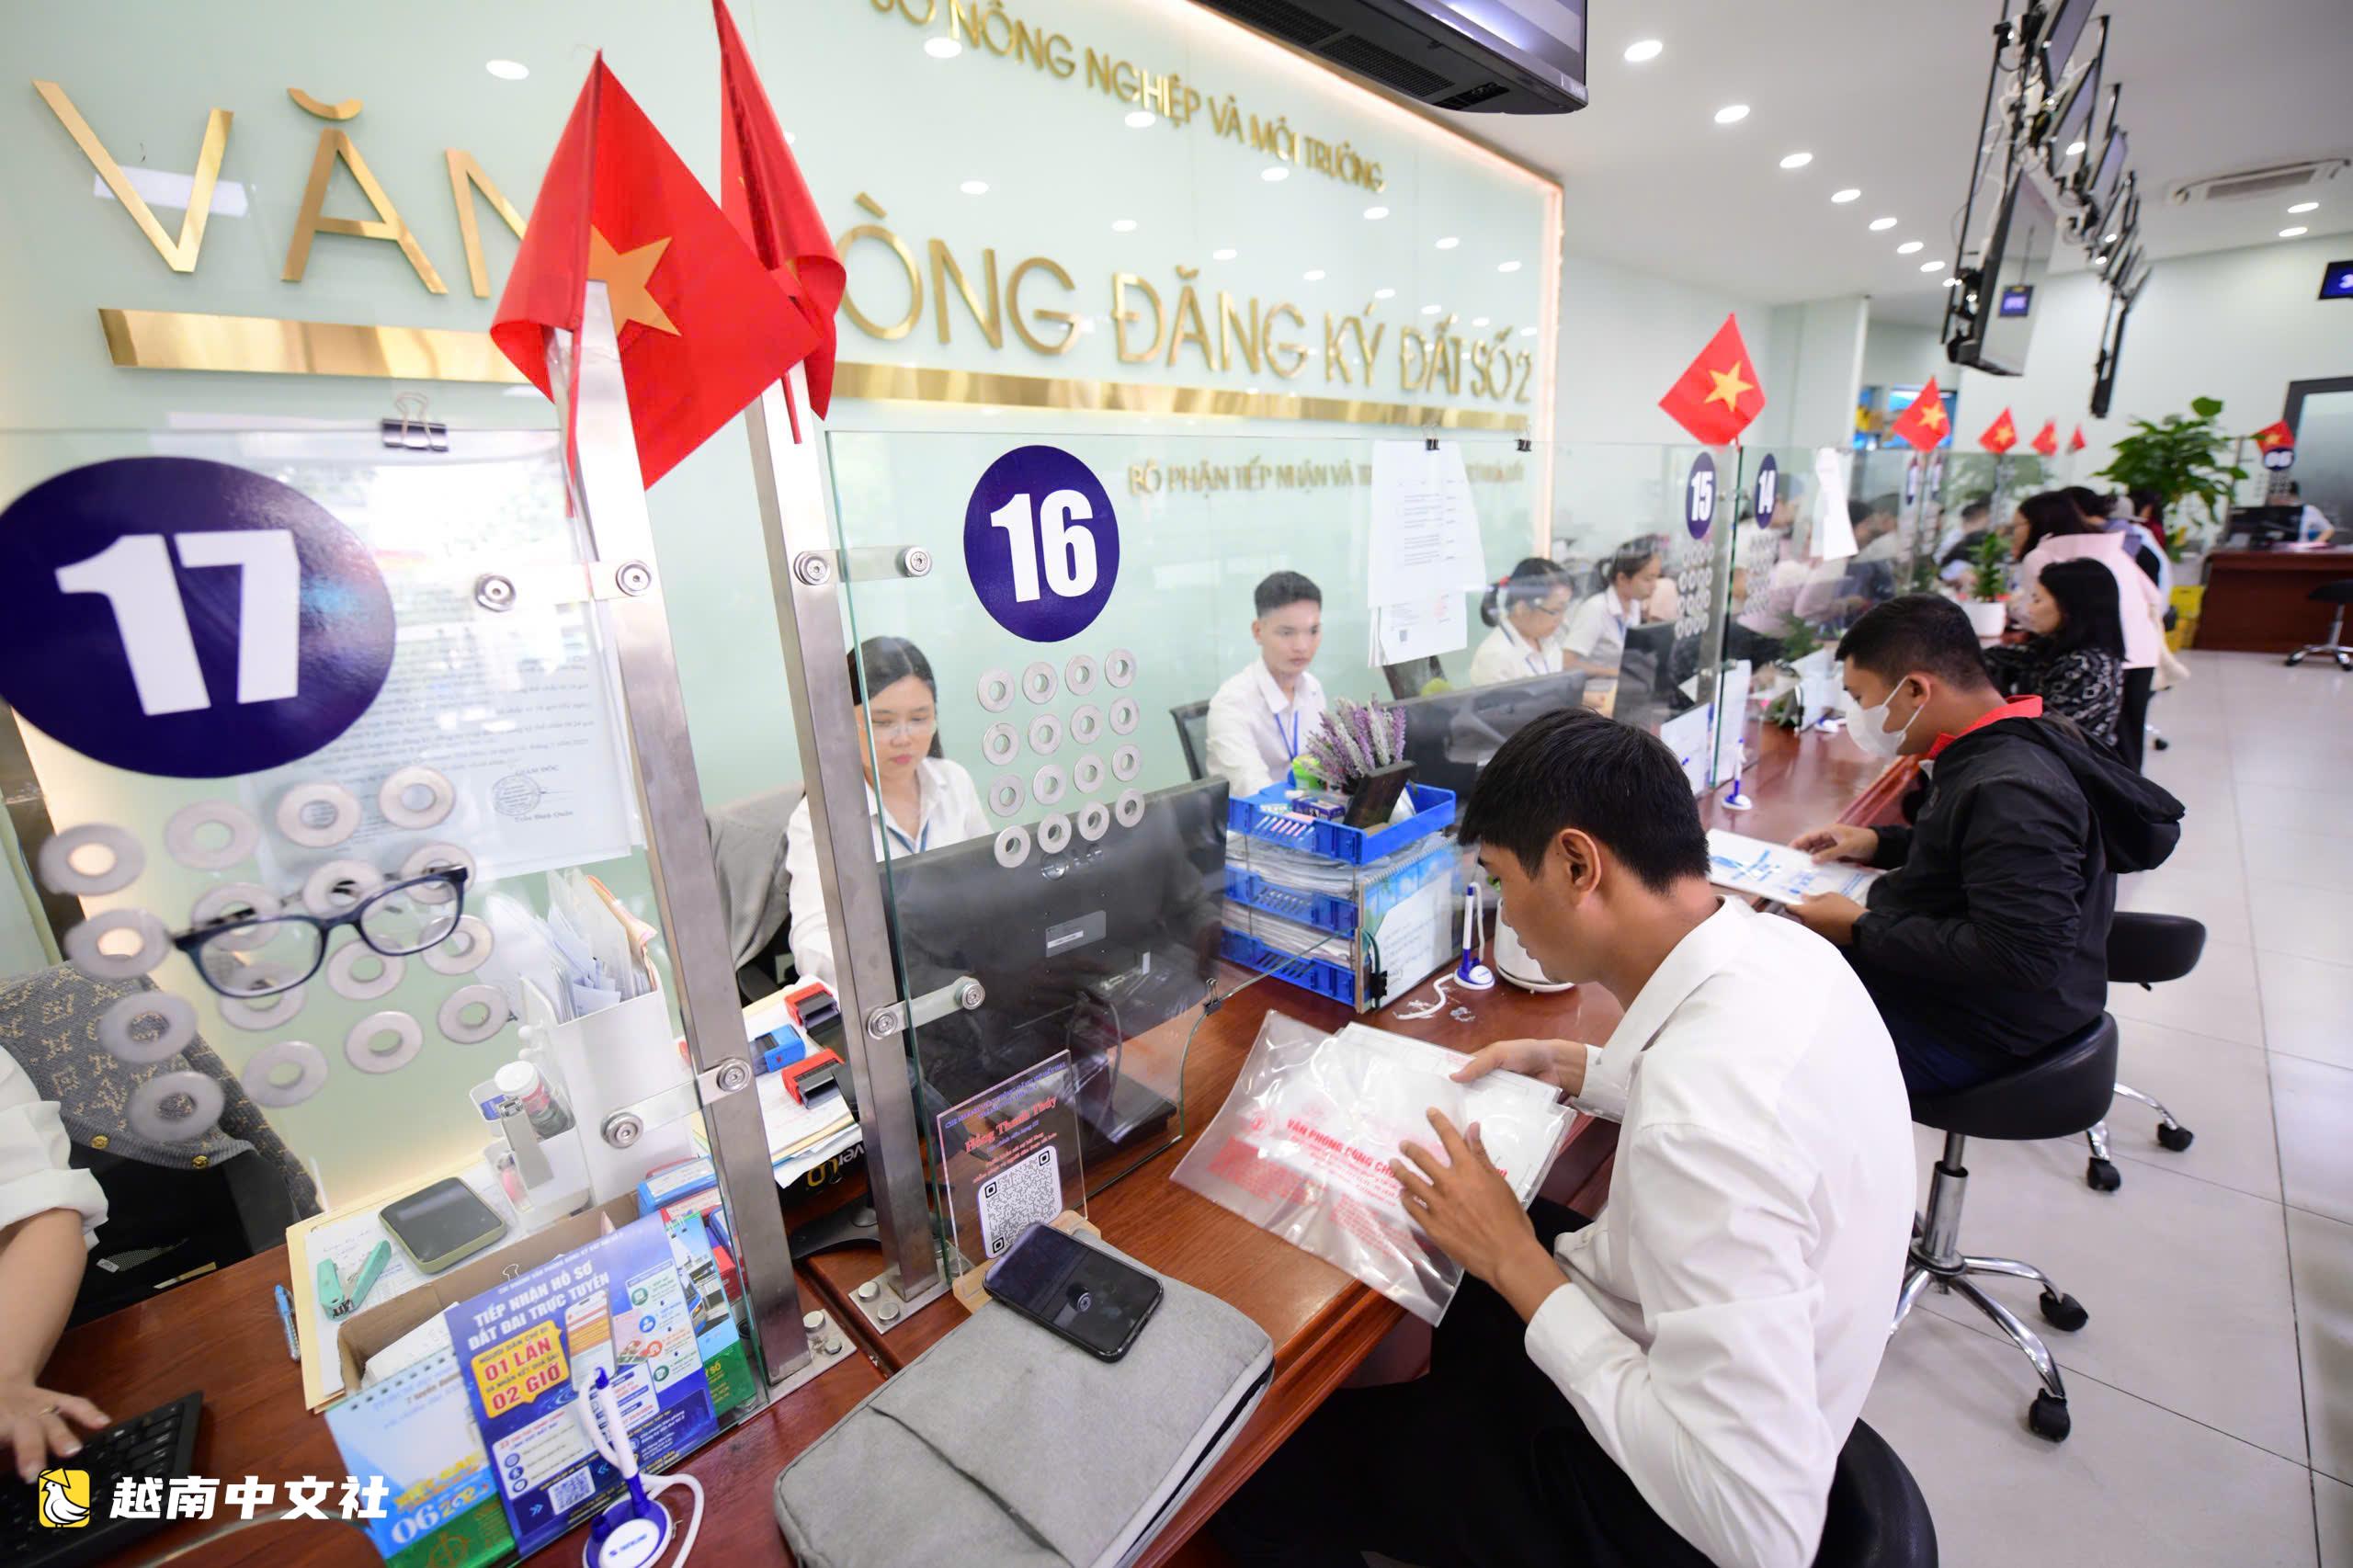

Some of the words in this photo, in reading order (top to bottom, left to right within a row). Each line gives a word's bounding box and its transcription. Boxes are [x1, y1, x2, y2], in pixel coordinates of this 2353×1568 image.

[1208, 95, 1245, 144] VÀ
[835, 191, 1082, 357] ÒNG
[1110, 264, 1309, 380] ĐĂNG
[1324, 302, 1385, 387] KÝ
[1399, 312, 1462, 395] ĐẤT
[1471, 325, 1514, 403] SỐ
[1515, 345, 1534, 403] 2
[1691, 471, 1714, 521] 15
[1758, 470, 1776, 515] 14
[990, 488, 1098, 604] 16
[55, 529, 301, 717] 17
[473, 1301, 506, 1327] TIẾP
[509, 1282, 549, 1312] NHẬN
[529, 1292, 567, 1321] TRỰC
[568, 1271, 610, 1302] TUYẾN
[483, 1358, 508, 1381] 01
[513, 1336, 552, 1368] LẦN
[492, 1386, 521, 1411] 02
[525, 1362, 562, 1393] GIỜ
[391, 1502, 439, 1545] 06
